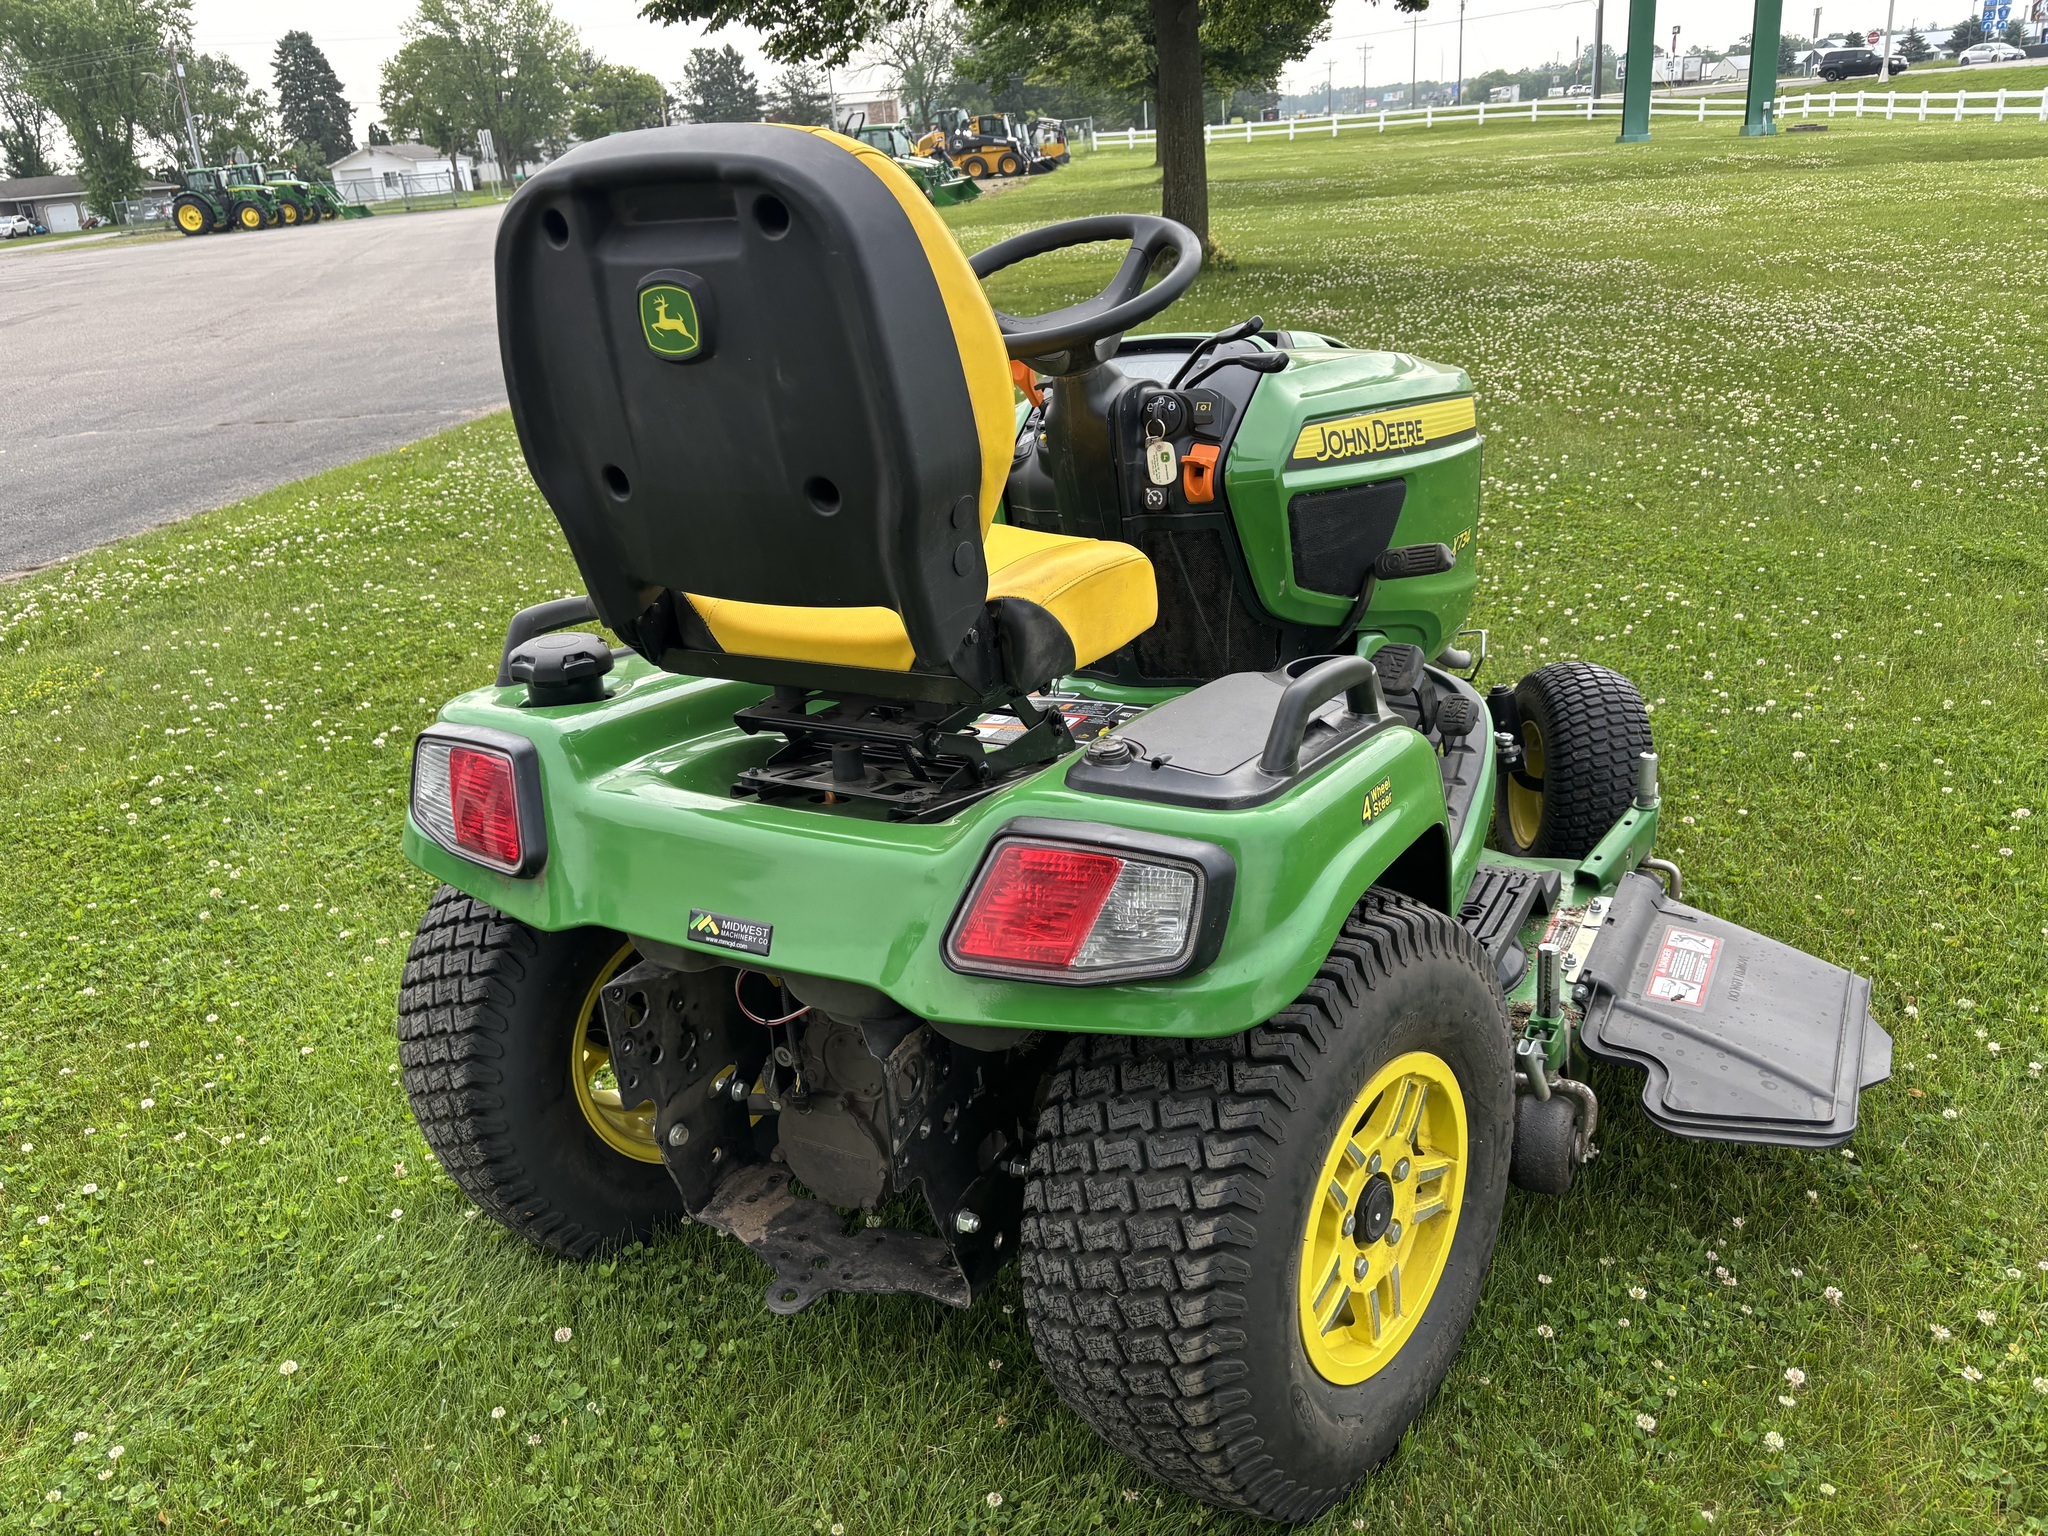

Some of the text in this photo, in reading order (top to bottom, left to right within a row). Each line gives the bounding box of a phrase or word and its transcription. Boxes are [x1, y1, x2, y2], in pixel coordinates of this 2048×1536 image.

[1984, 11, 1994, 19] 23
[1316, 419, 1424, 458] JOHN DEERE
[1371, 776, 1390, 802] Wheel
[1363, 796, 1371, 820] 4
[1373, 792, 1392, 816] Steer
[720, 930, 758, 943] MACHINERY
[721, 920, 769, 938] MIDWEST
